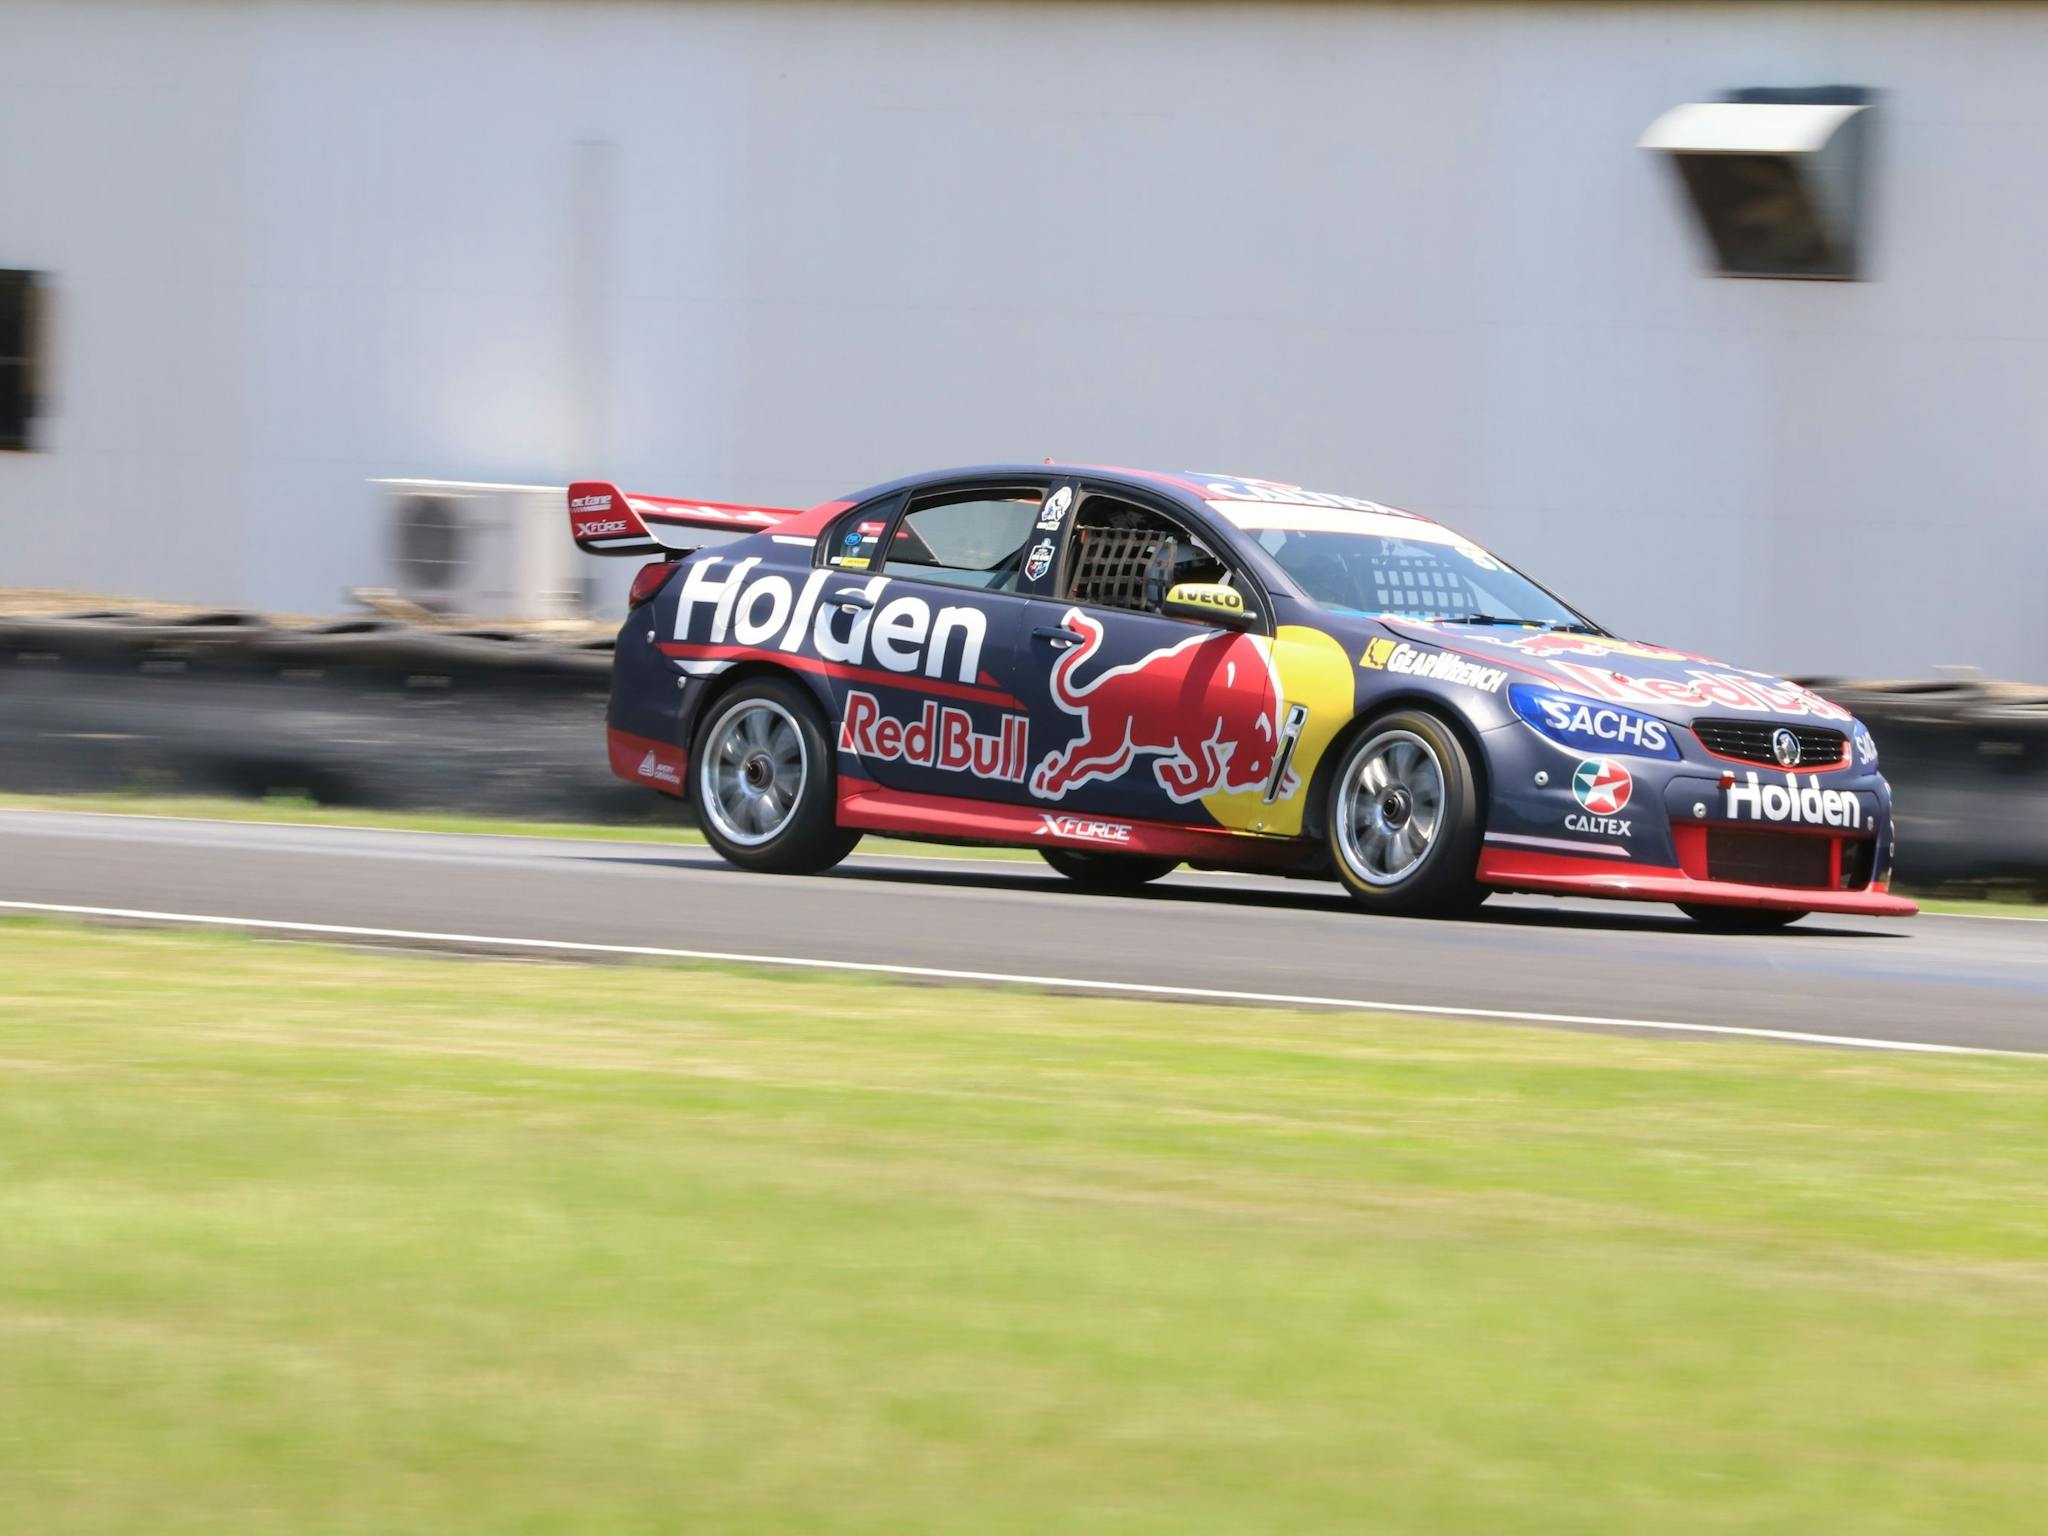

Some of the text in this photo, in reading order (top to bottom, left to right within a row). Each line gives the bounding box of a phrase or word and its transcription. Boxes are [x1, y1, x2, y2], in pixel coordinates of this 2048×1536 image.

[1177, 588, 1240, 608] IVECO
[672, 556, 988, 685] Holden
[1539, 699, 1668, 752] SACHS
[1722, 771, 1861, 829] Holden
[1031, 813, 1133, 845] XFORCE
[1564, 814, 1632, 837] CALTEX
